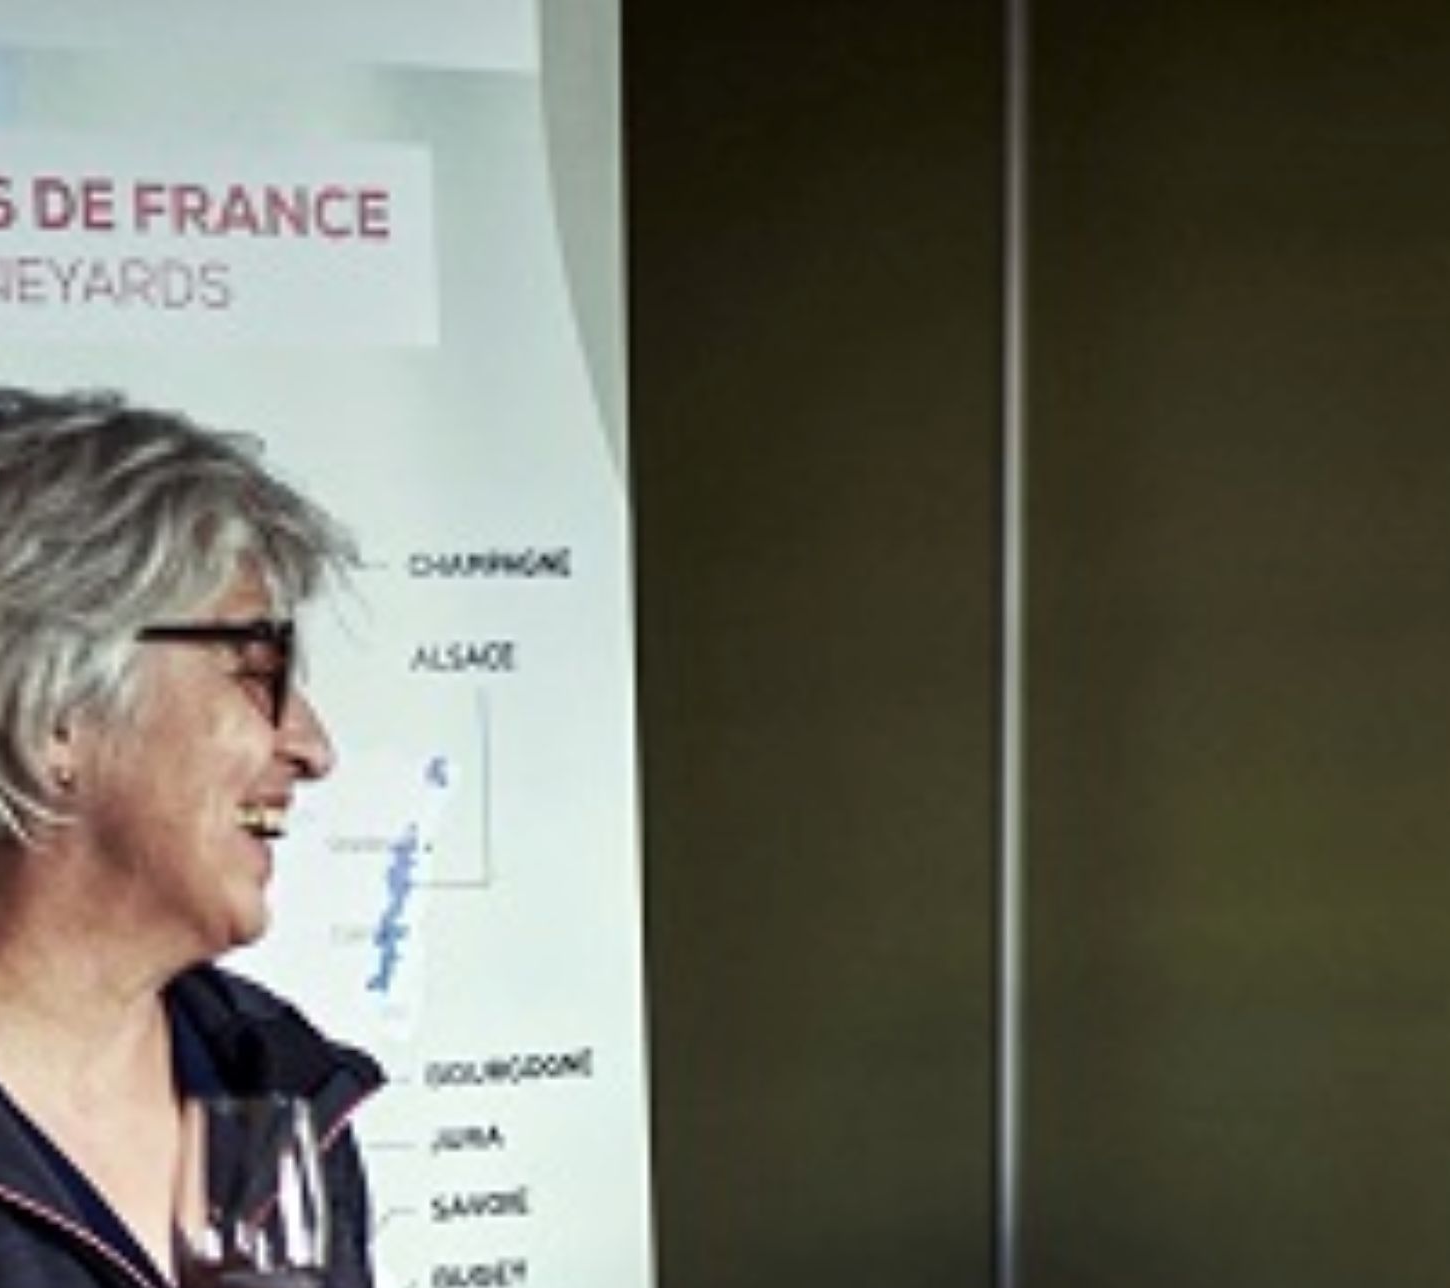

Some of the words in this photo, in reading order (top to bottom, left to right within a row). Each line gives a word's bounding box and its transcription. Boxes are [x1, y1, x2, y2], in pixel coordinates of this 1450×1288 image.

[33, 177, 115, 231] DE
[134, 182, 390, 239] FRANCE
[408, 547, 571, 579] CHAMPAGNE
[409, 640, 518, 673] ALSACE
[424, 1048, 593, 1090] BOURGOGNE
[431, 1124, 504, 1155] JURA
[430, 1186, 531, 1223] SAVOIE
